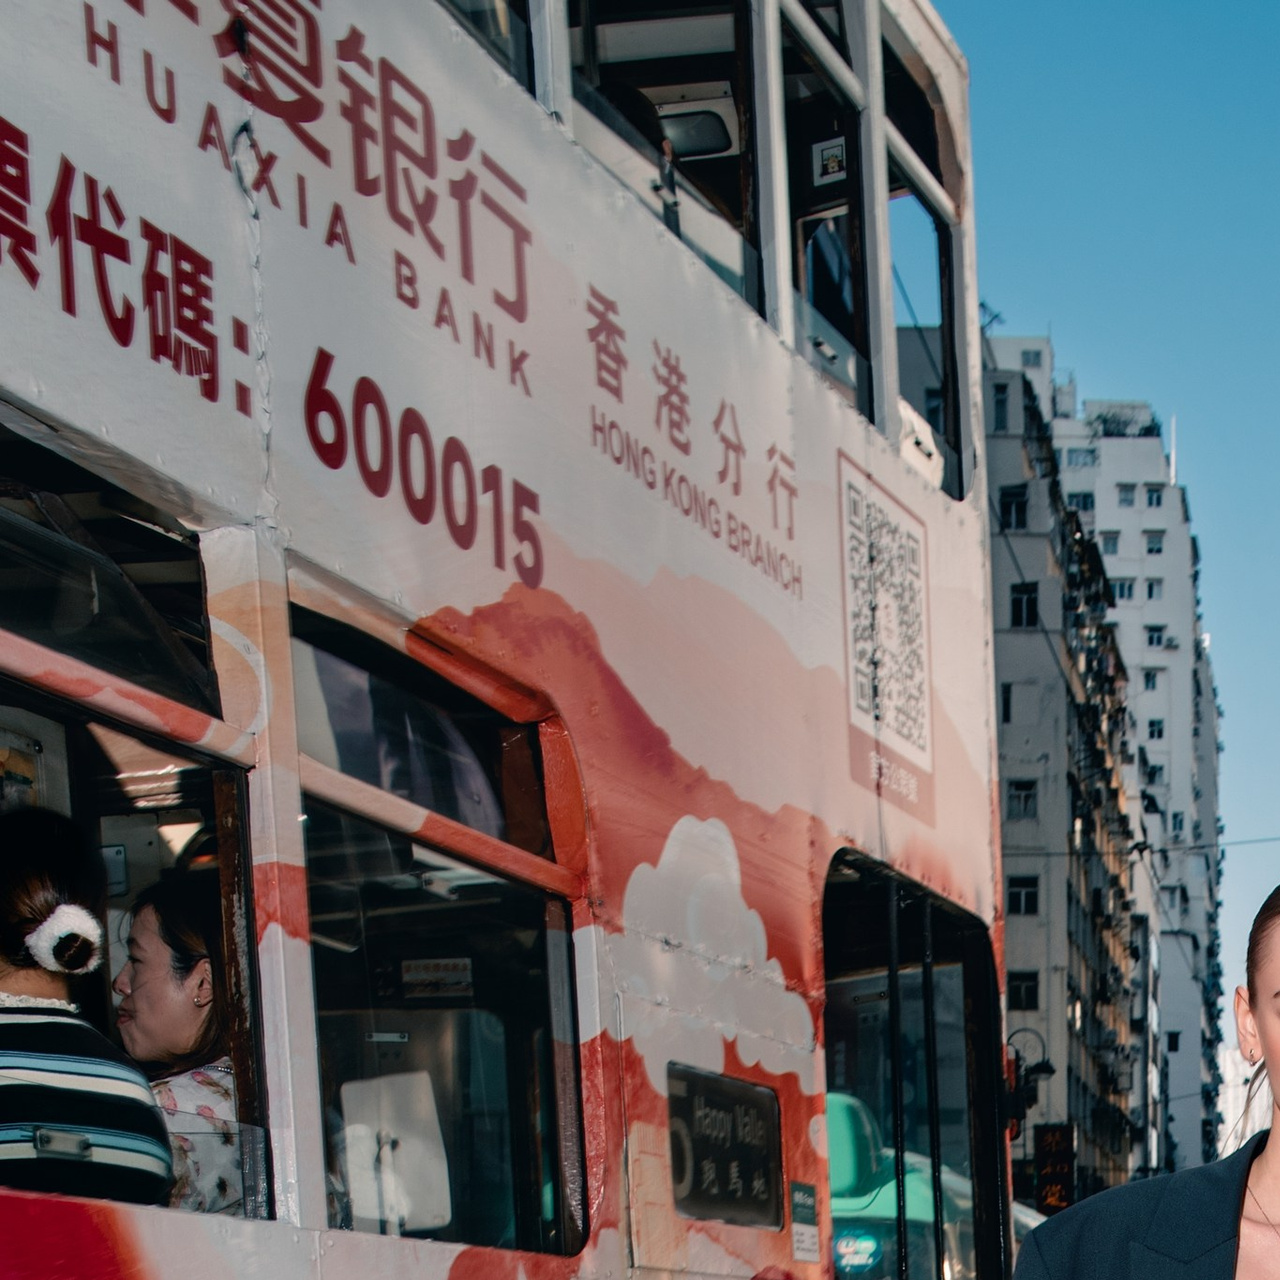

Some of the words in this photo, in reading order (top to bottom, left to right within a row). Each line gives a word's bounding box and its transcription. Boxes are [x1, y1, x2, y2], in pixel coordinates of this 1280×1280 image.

[83, 1, 356, 266] HUAXIA
[394, 248, 532, 398] BANK
[124, 0, 532, 323] 夏银行
[304, 345, 544, 590] 600015
[585, 284, 799, 541] 香港分行
[590, 404, 657, 492] HONG
[661, 458, 722, 540] KONG
[727, 501, 804, 601] BRANCH
[693, 1096, 733, 1149] Happy
